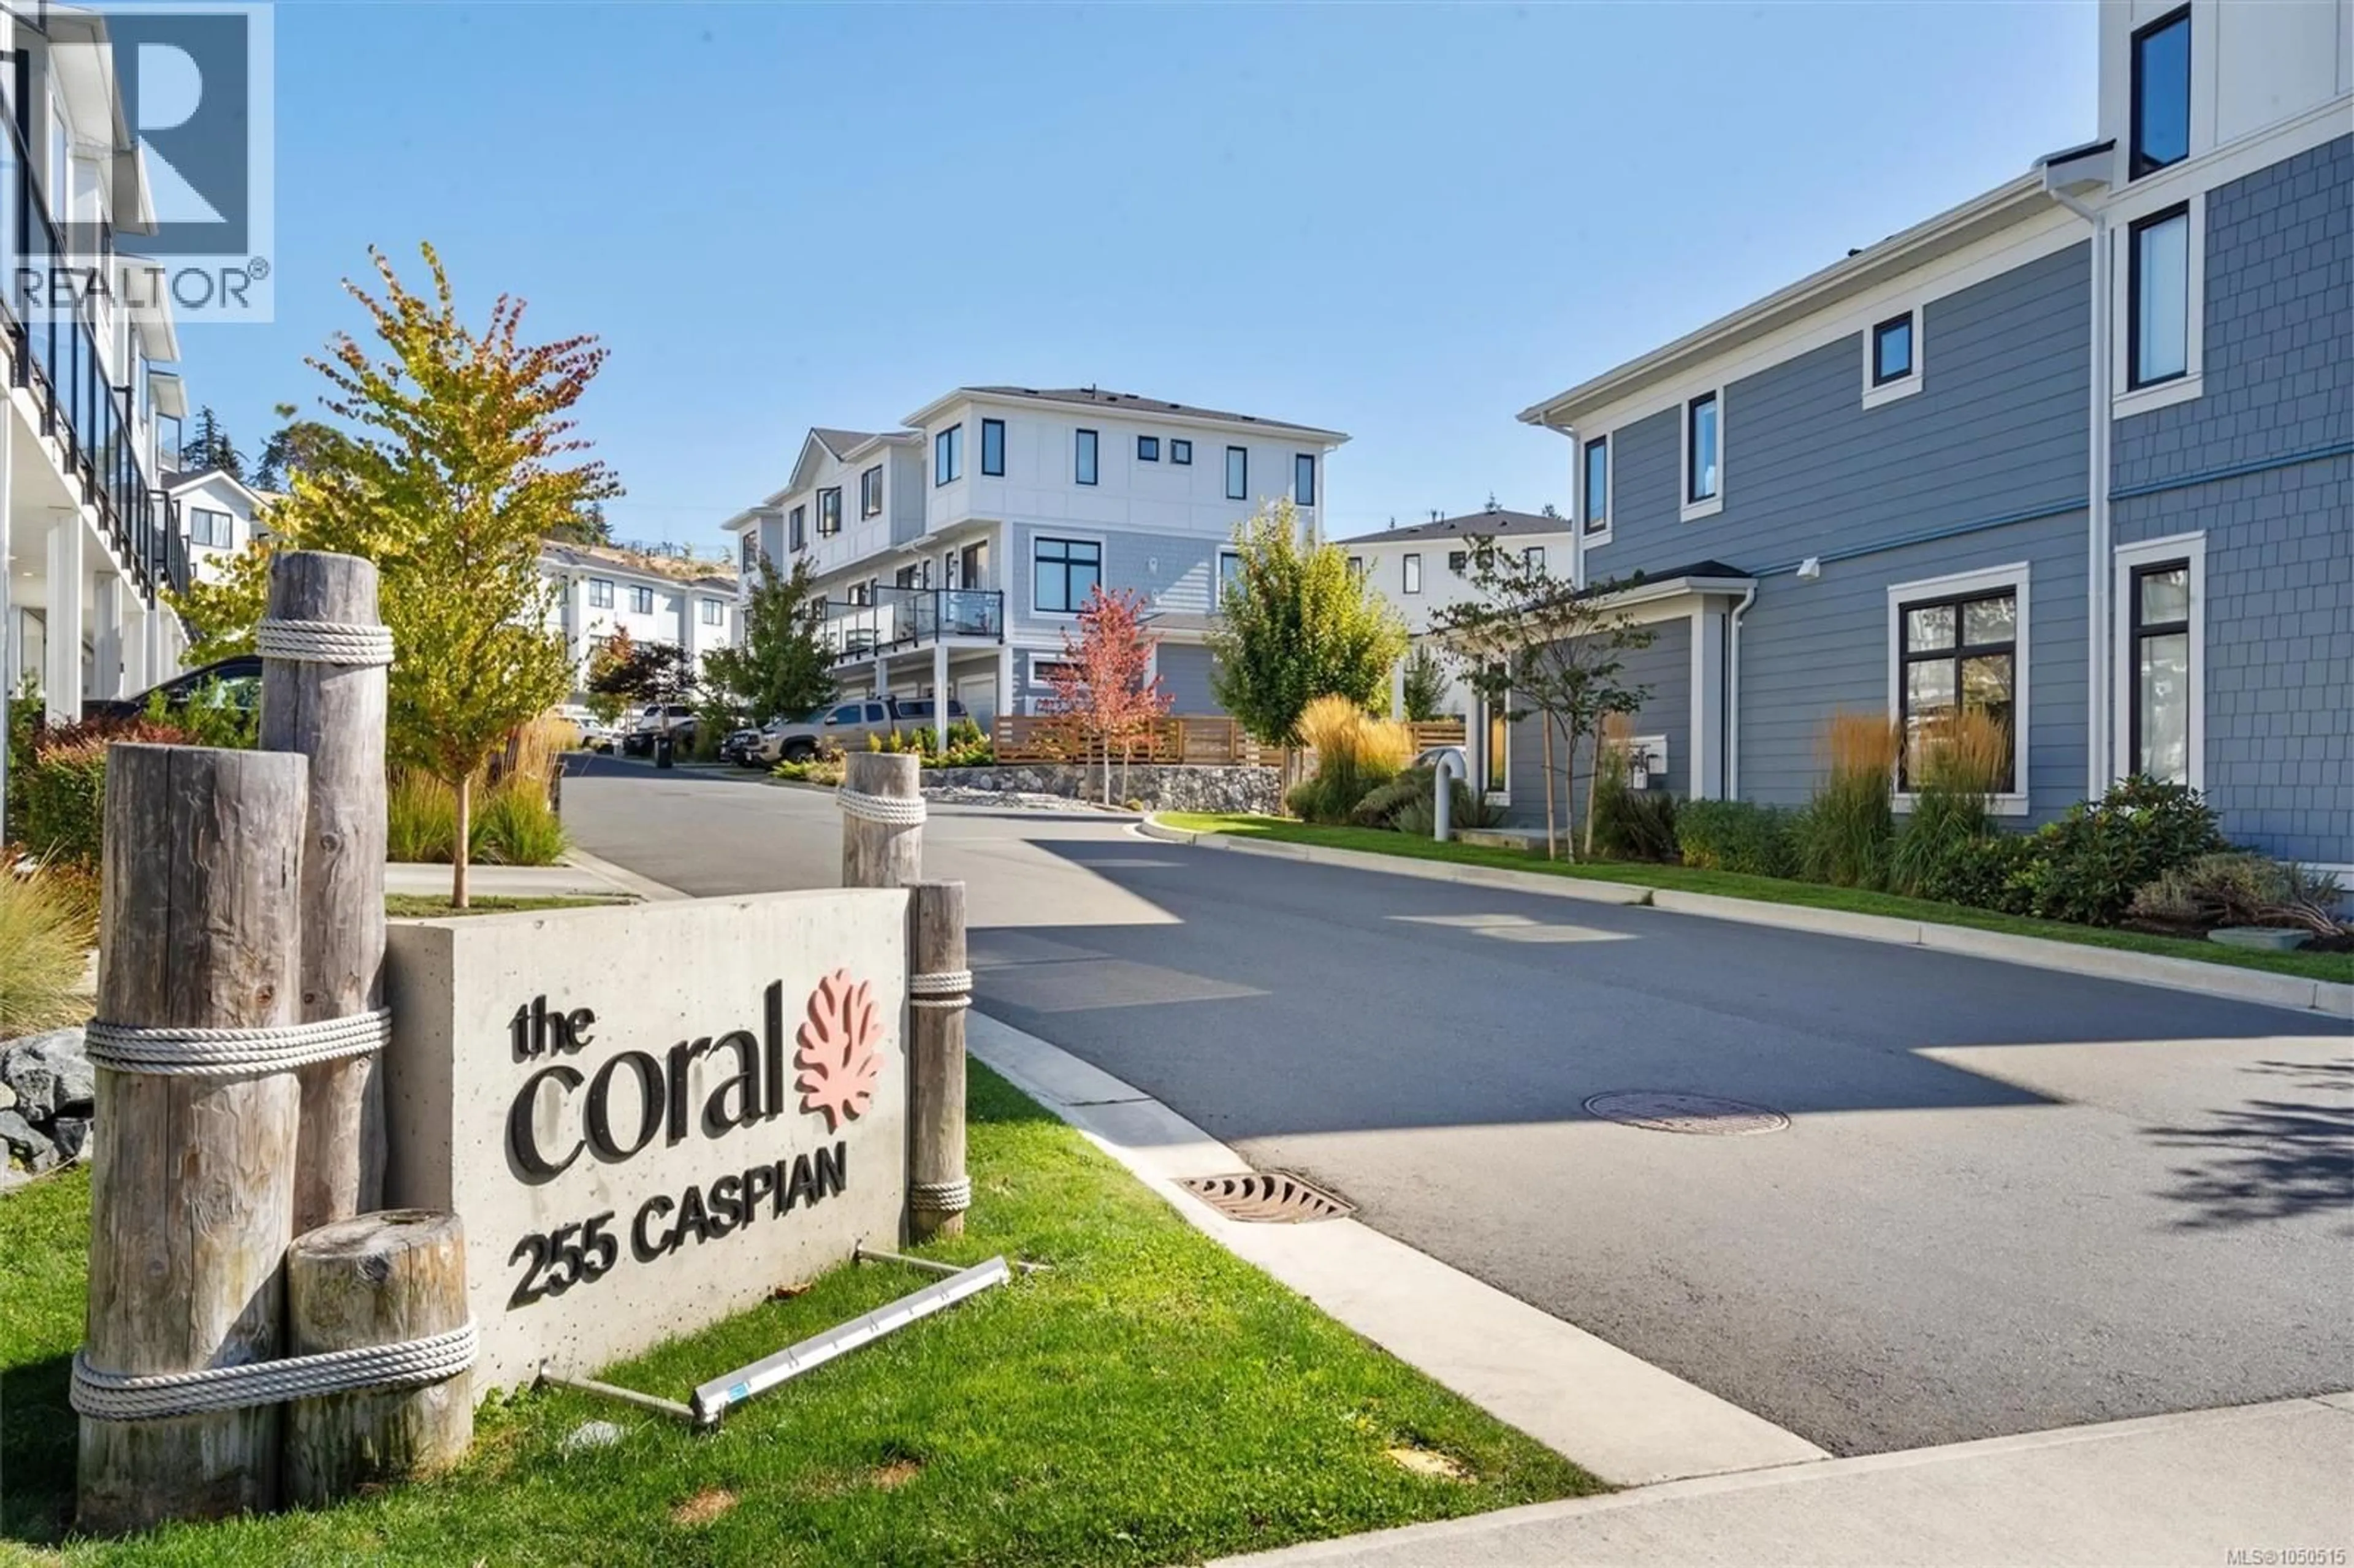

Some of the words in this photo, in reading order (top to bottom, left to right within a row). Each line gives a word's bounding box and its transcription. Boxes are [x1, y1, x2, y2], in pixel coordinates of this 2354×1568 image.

[507, 994, 595, 1064] the
[506, 1211, 618, 1311] 255
[631, 1141, 847, 1263] CASPIAN
